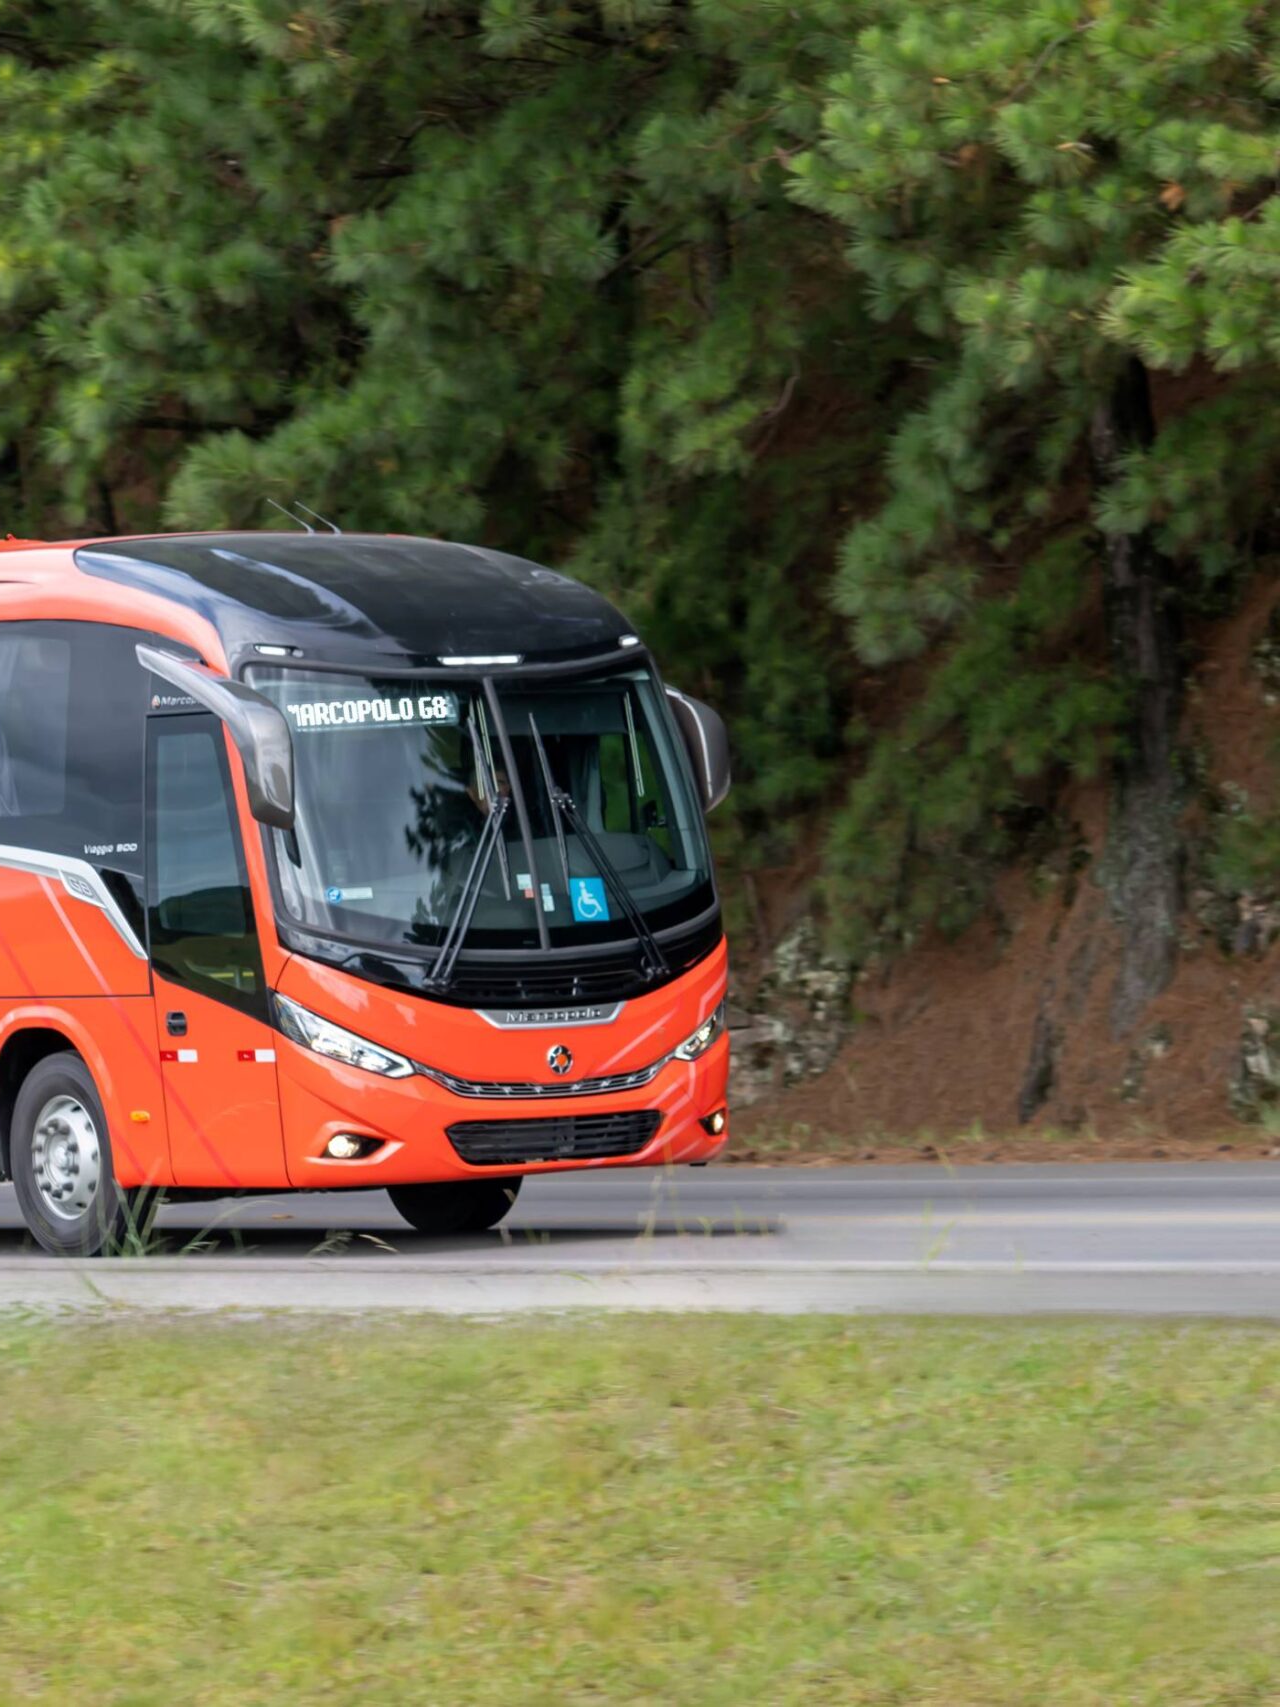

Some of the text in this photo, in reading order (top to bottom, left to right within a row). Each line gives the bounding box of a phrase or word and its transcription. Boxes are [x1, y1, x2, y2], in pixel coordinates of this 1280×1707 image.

[417, 696, 448, 720] G8
[83, 844, 114, 856] Viaggio
[505, 1007, 602, 1023] Marcopolo
